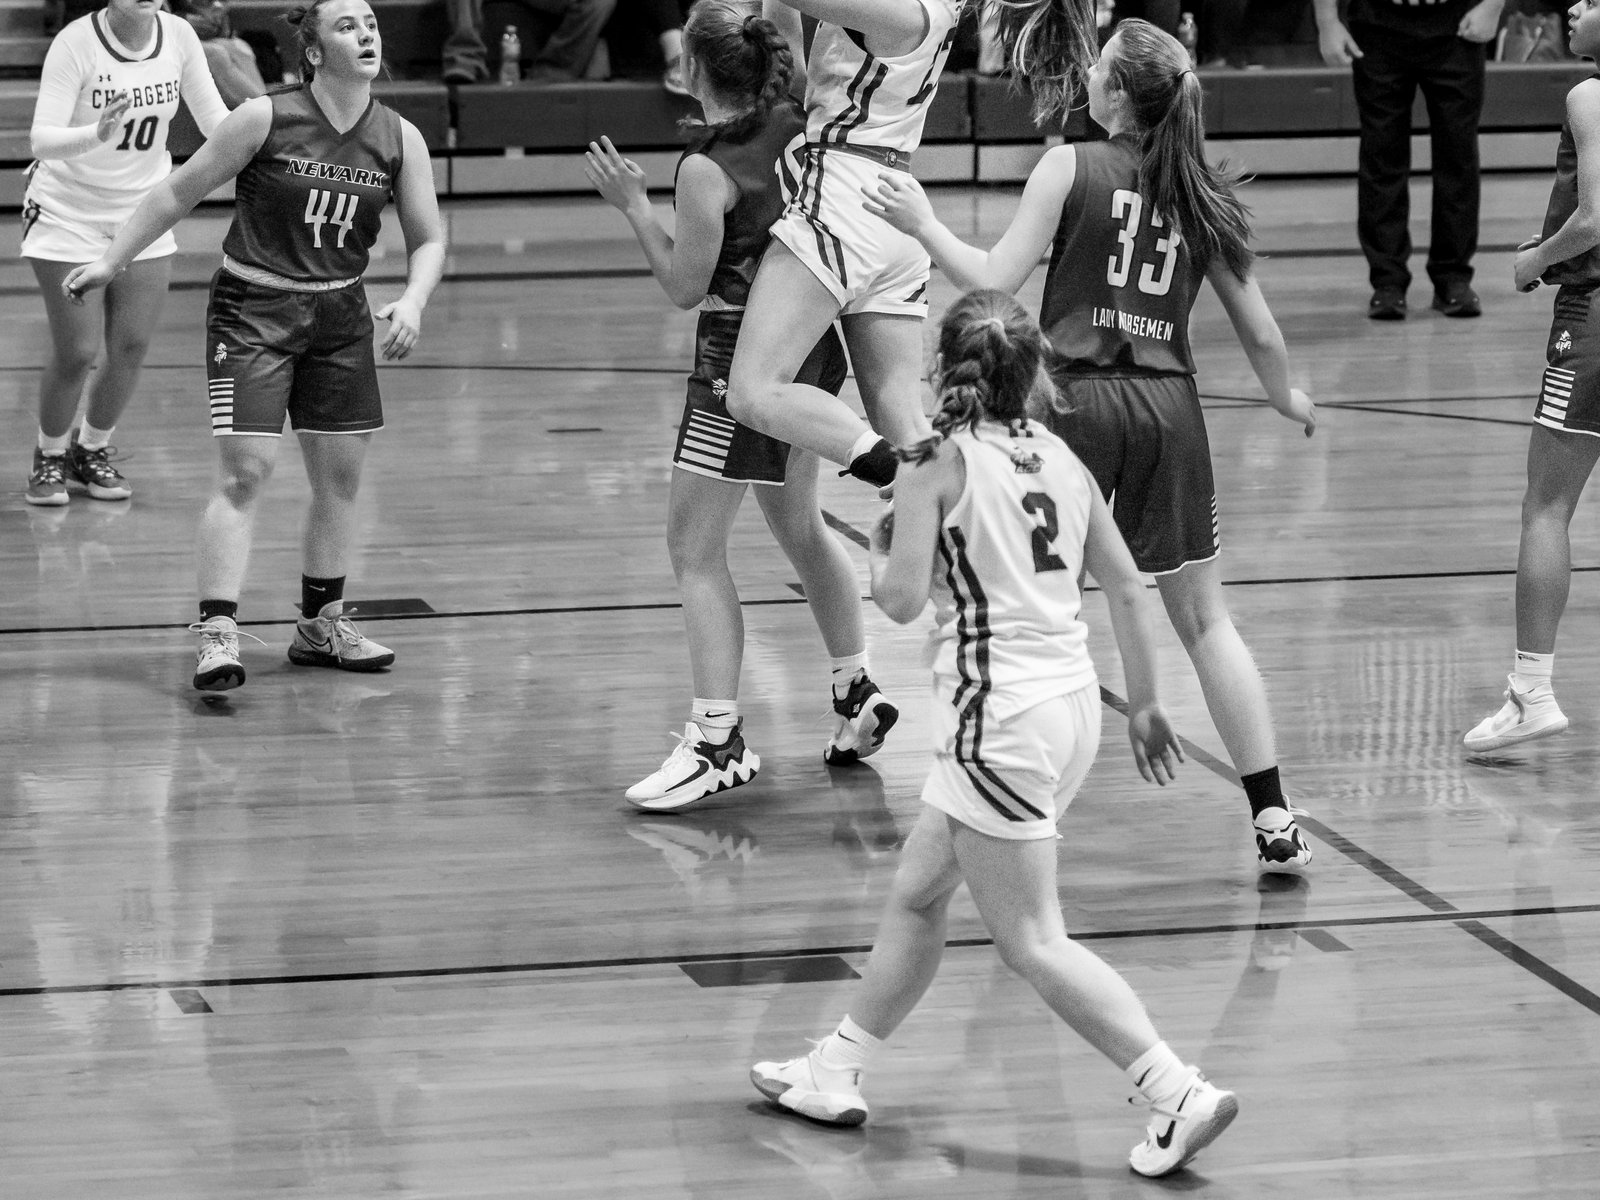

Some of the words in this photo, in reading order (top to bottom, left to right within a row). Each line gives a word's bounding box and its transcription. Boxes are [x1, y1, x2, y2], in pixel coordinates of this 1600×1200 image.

[92, 80, 179, 109] CHRGERS
[116, 115, 159, 151] 10
[285, 159, 386, 188] NEWARK
[304, 188, 359, 248] 44
[1107, 189, 1181, 296] 33
[1021, 491, 1068, 573] 2
